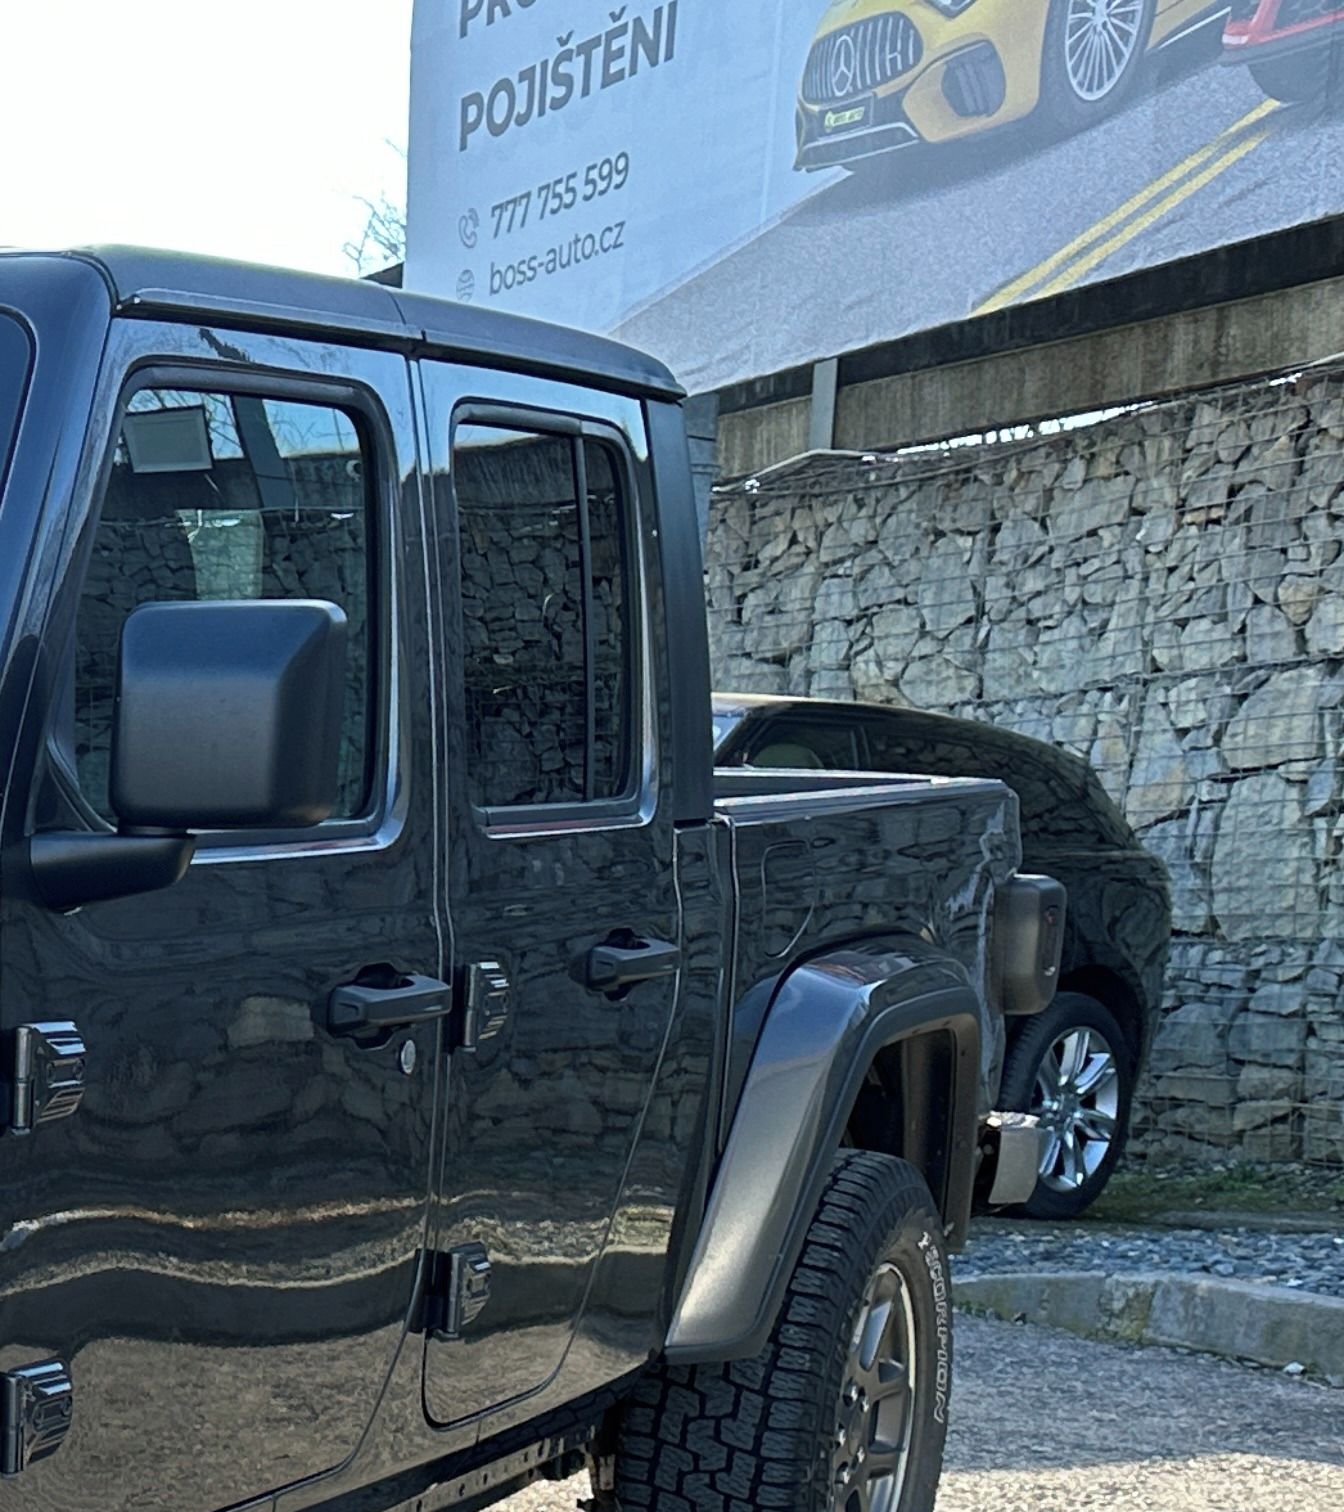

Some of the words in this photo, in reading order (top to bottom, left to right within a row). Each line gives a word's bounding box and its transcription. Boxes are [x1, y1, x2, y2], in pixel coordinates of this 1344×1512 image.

[490, 191, 530, 239] 777
[538, 174, 577, 219] 755
[583, 151, 630, 201] 599
[489, 221, 625, 296] boss-auto.cz
